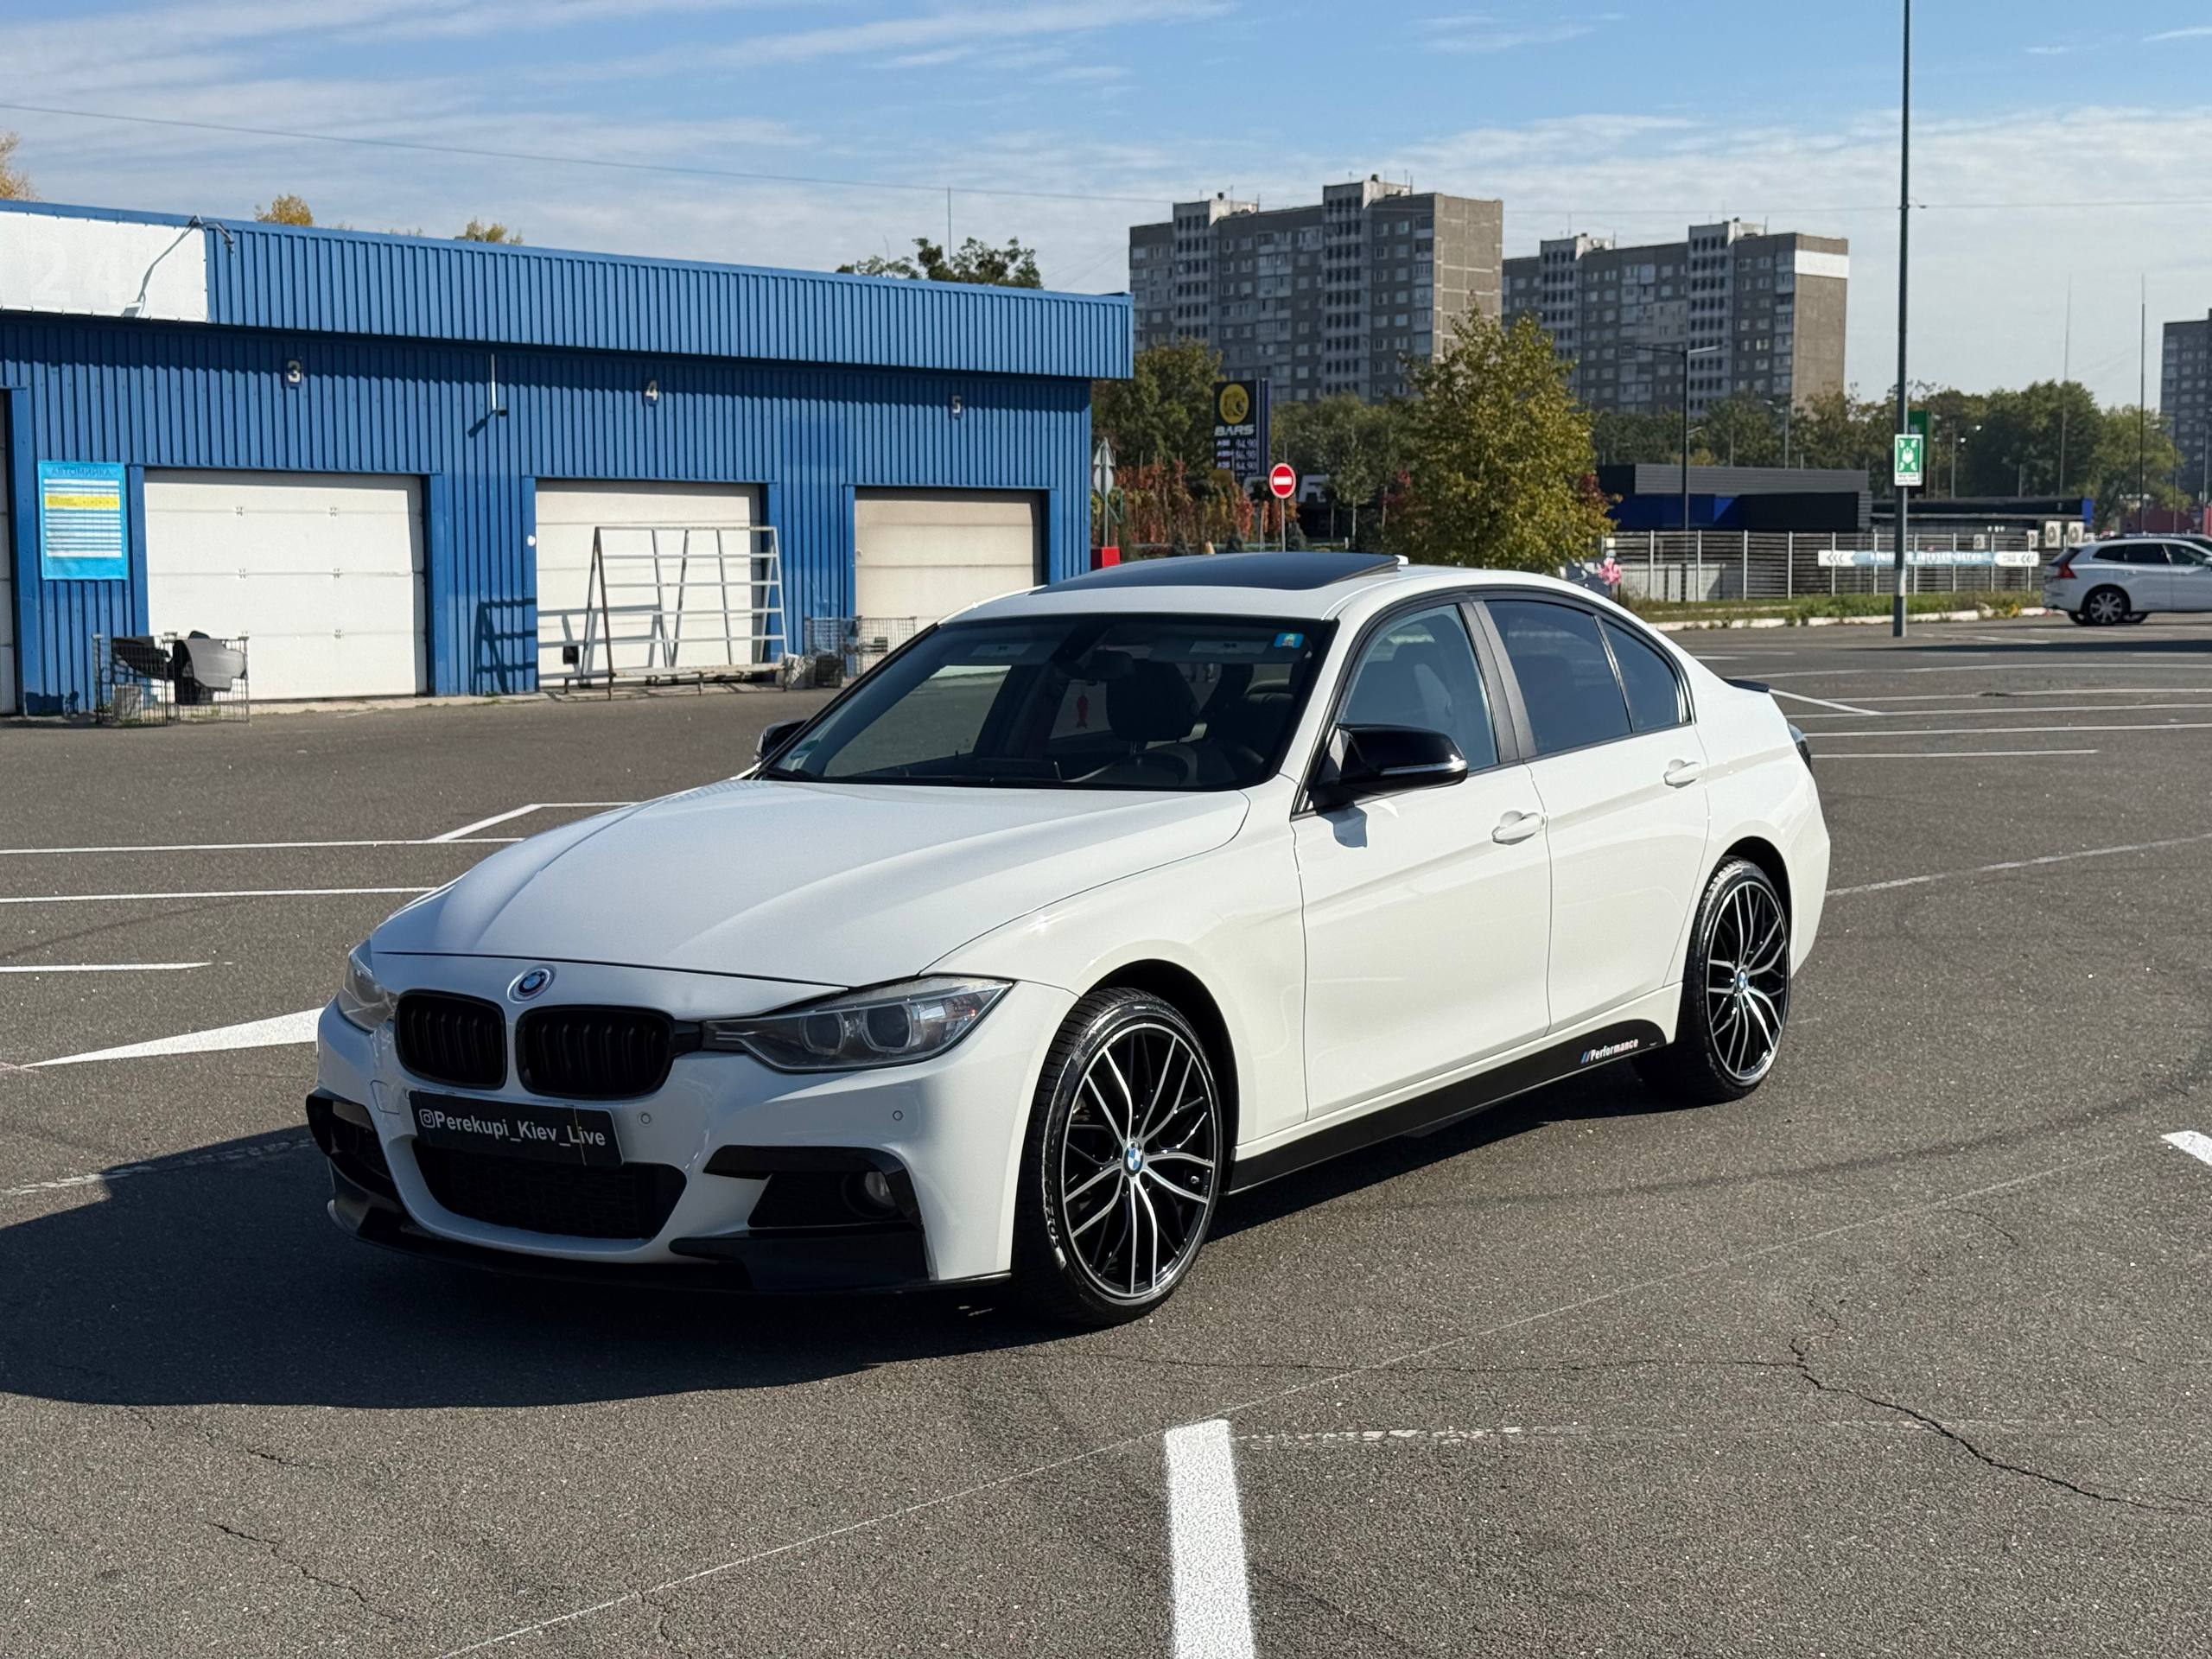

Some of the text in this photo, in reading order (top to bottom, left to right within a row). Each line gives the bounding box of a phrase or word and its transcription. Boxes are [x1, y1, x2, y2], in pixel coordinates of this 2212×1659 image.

[287, 359, 301, 383] 3
[645, 380, 658, 401] 4
[951, 395, 962, 413] 5
[1214, 424, 1255, 436] BARS
